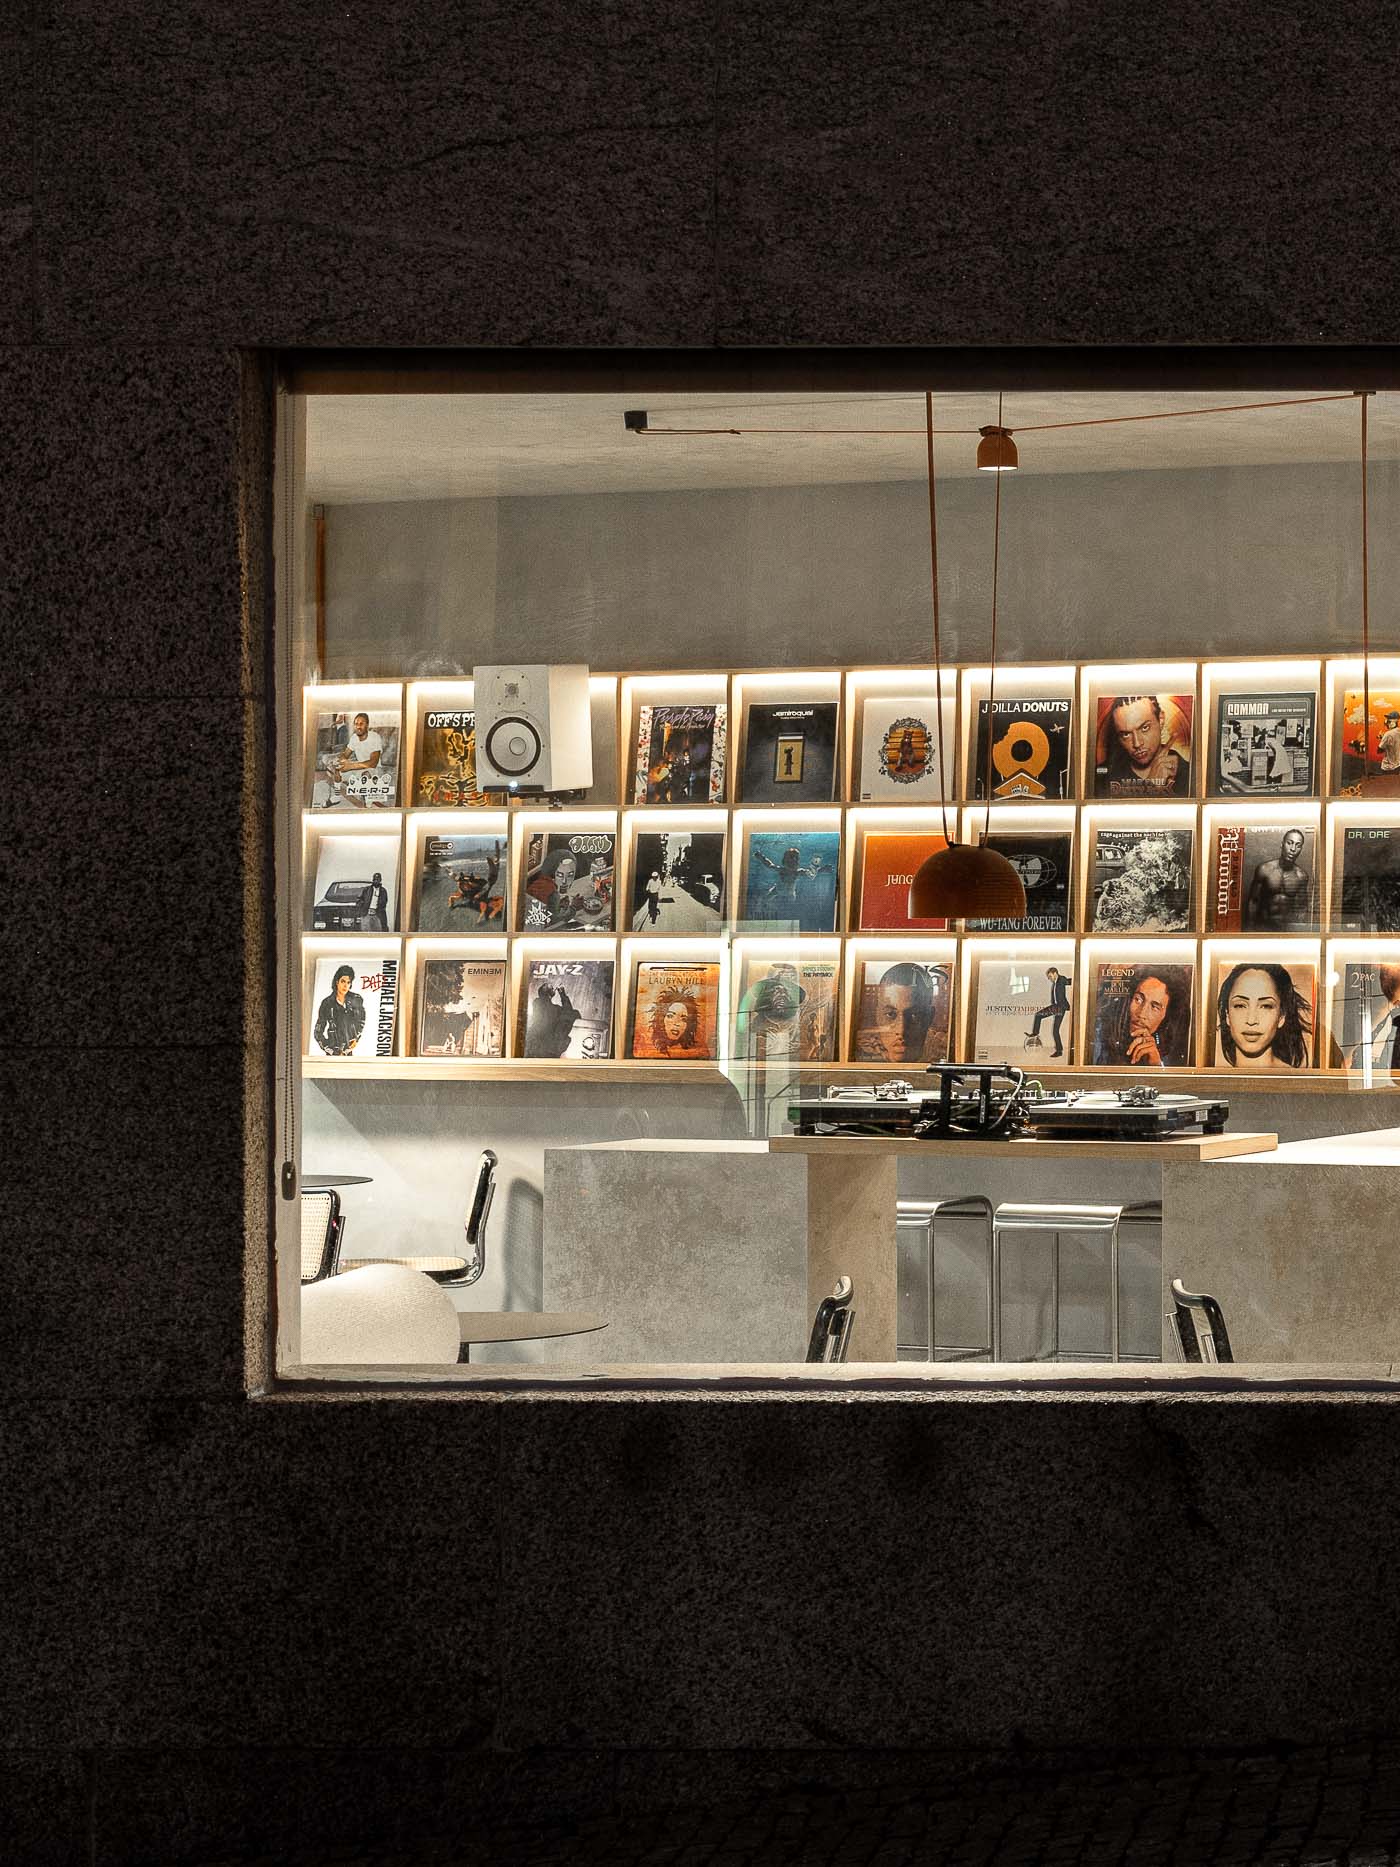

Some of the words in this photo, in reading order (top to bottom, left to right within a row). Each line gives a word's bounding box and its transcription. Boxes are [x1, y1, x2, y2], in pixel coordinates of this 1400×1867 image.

[981, 703, 988, 713] J
[991, 703, 1020, 713] DILLA
[1022, 702, 1069, 712] DONUTS
[1227, 703, 1269, 716] COMMON
[884, 874, 914, 887] JUNG
[1022, 916, 1062, 930] FOREVER
[533, 964, 584, 976] JAY-Z
[1101, 968, 1135, 977] LEGEND
[379, 960, 397, 1007] MICHAEL
[648, 977, 682, 985] LAURYN
[376, 1007, 394, 1057] JACKSON
